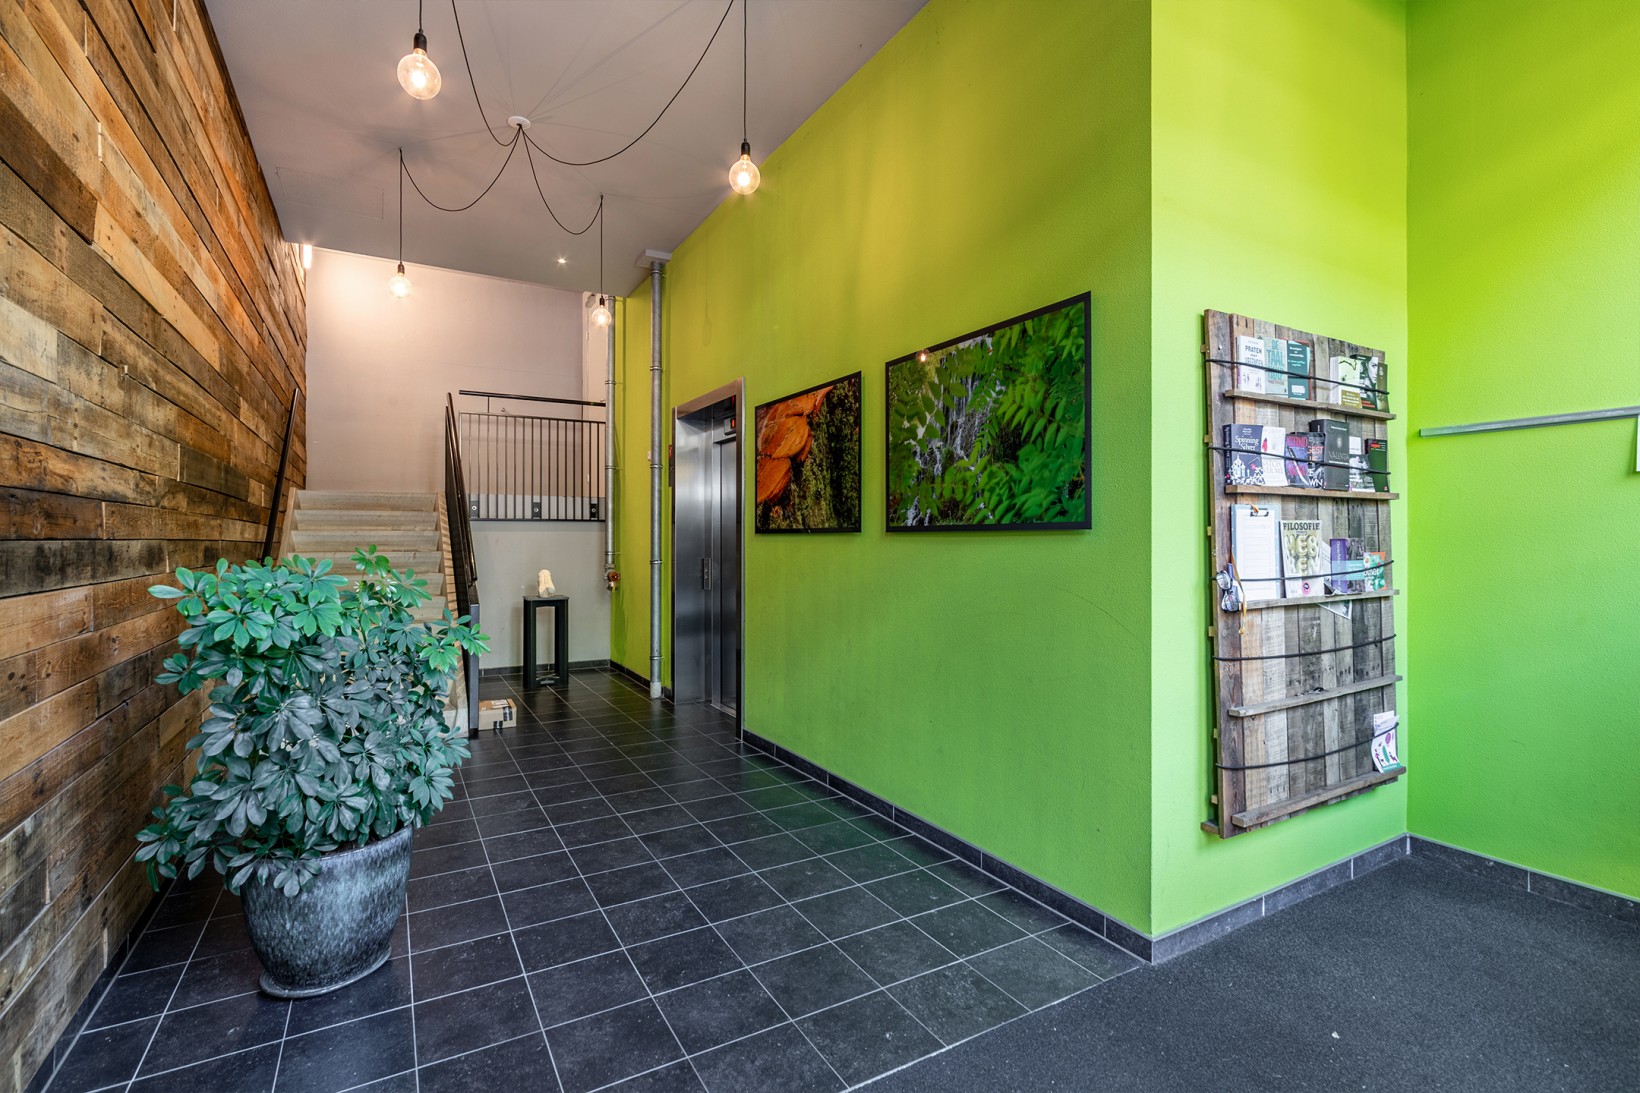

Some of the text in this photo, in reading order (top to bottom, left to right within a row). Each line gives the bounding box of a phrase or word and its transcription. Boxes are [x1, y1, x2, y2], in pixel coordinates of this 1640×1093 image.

[1245, 345, 1262, 354] PRATEN
[1235, 435, 1259, 446] Spinning
[1283, 522, 1320, 531] FILOSOFIE
